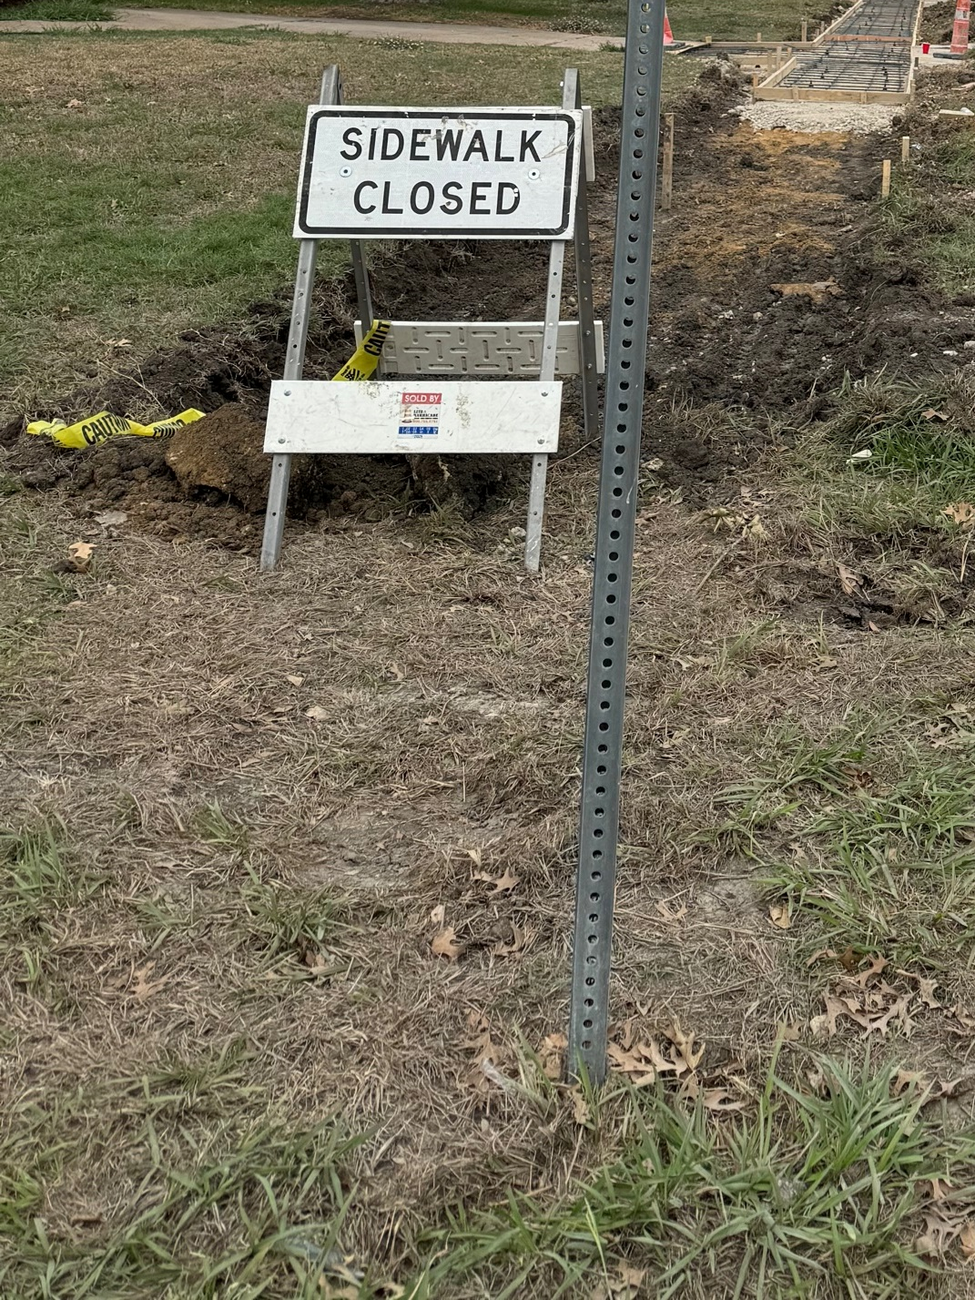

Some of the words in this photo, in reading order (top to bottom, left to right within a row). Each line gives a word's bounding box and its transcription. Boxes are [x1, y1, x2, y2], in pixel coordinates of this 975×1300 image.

[339, 126, 543, 163] SIDEWALK
[353, 180, 521, 216] CLOSED
[404, 394, 428, 403] SOLD
[429, 394, 440, 404] BY
